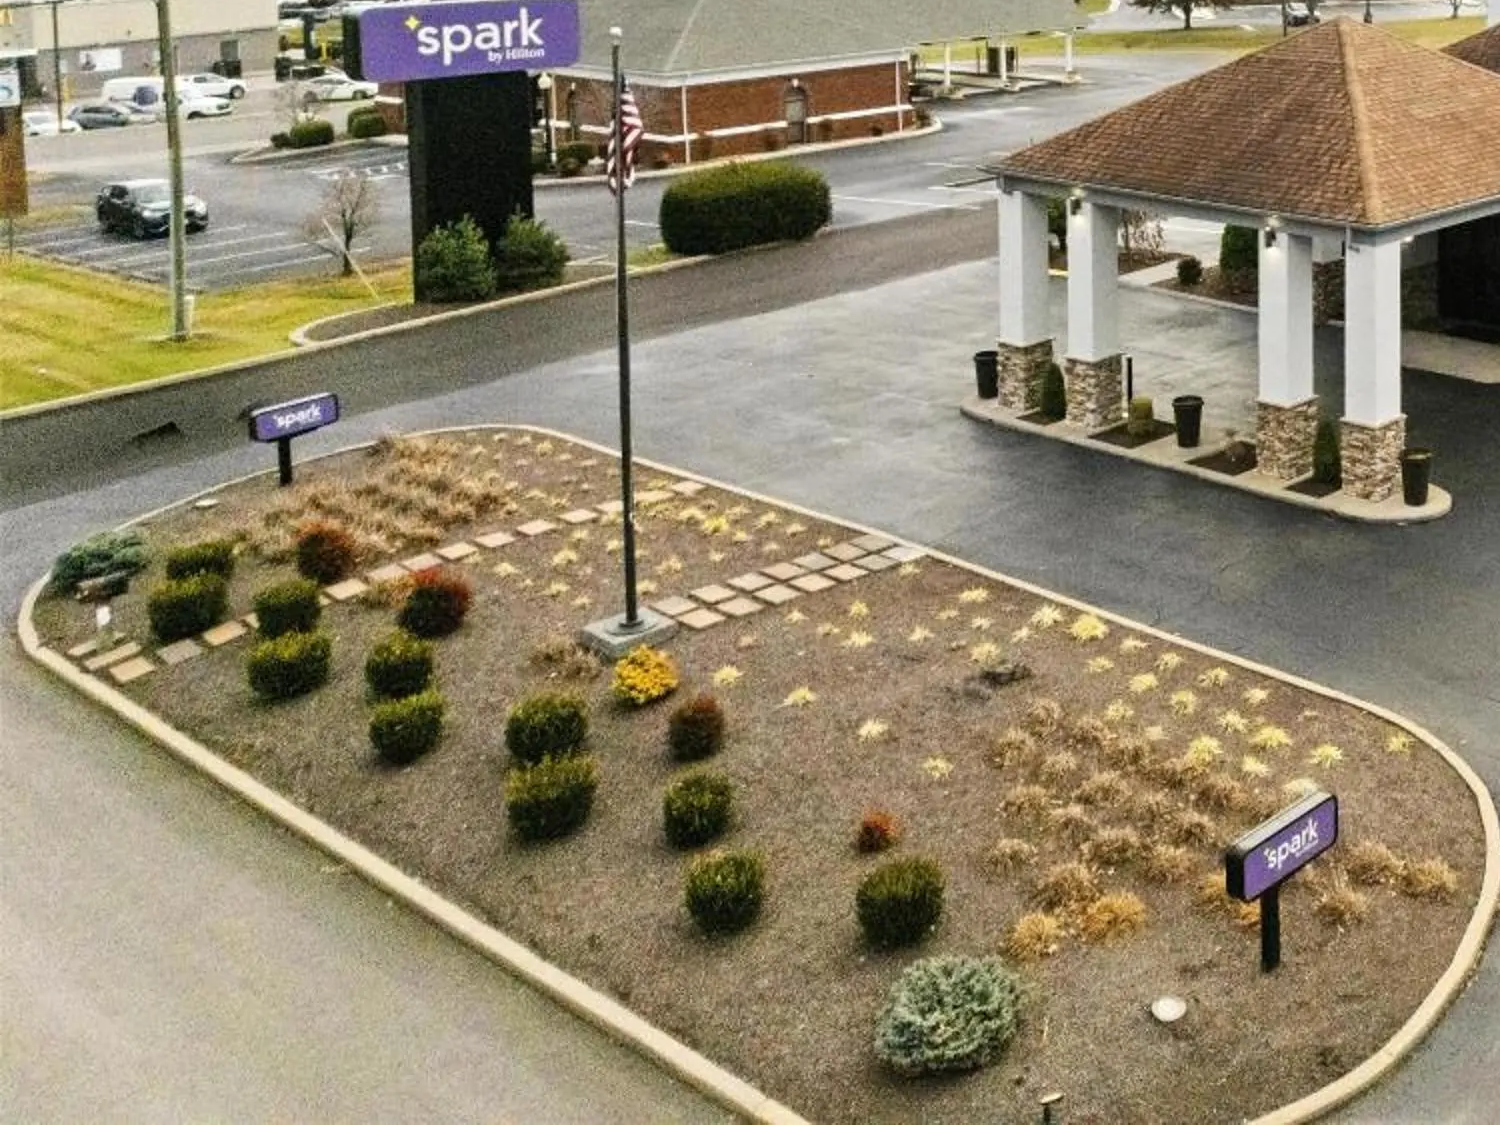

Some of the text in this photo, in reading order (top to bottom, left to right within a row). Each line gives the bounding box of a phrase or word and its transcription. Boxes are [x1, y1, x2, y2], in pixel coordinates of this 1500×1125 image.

[417, 7, 544, 66] spark
[488, 50, 502, 64] by
[276, 404, 321, 428] spark
[1266, 818, 1318, 869] spark
